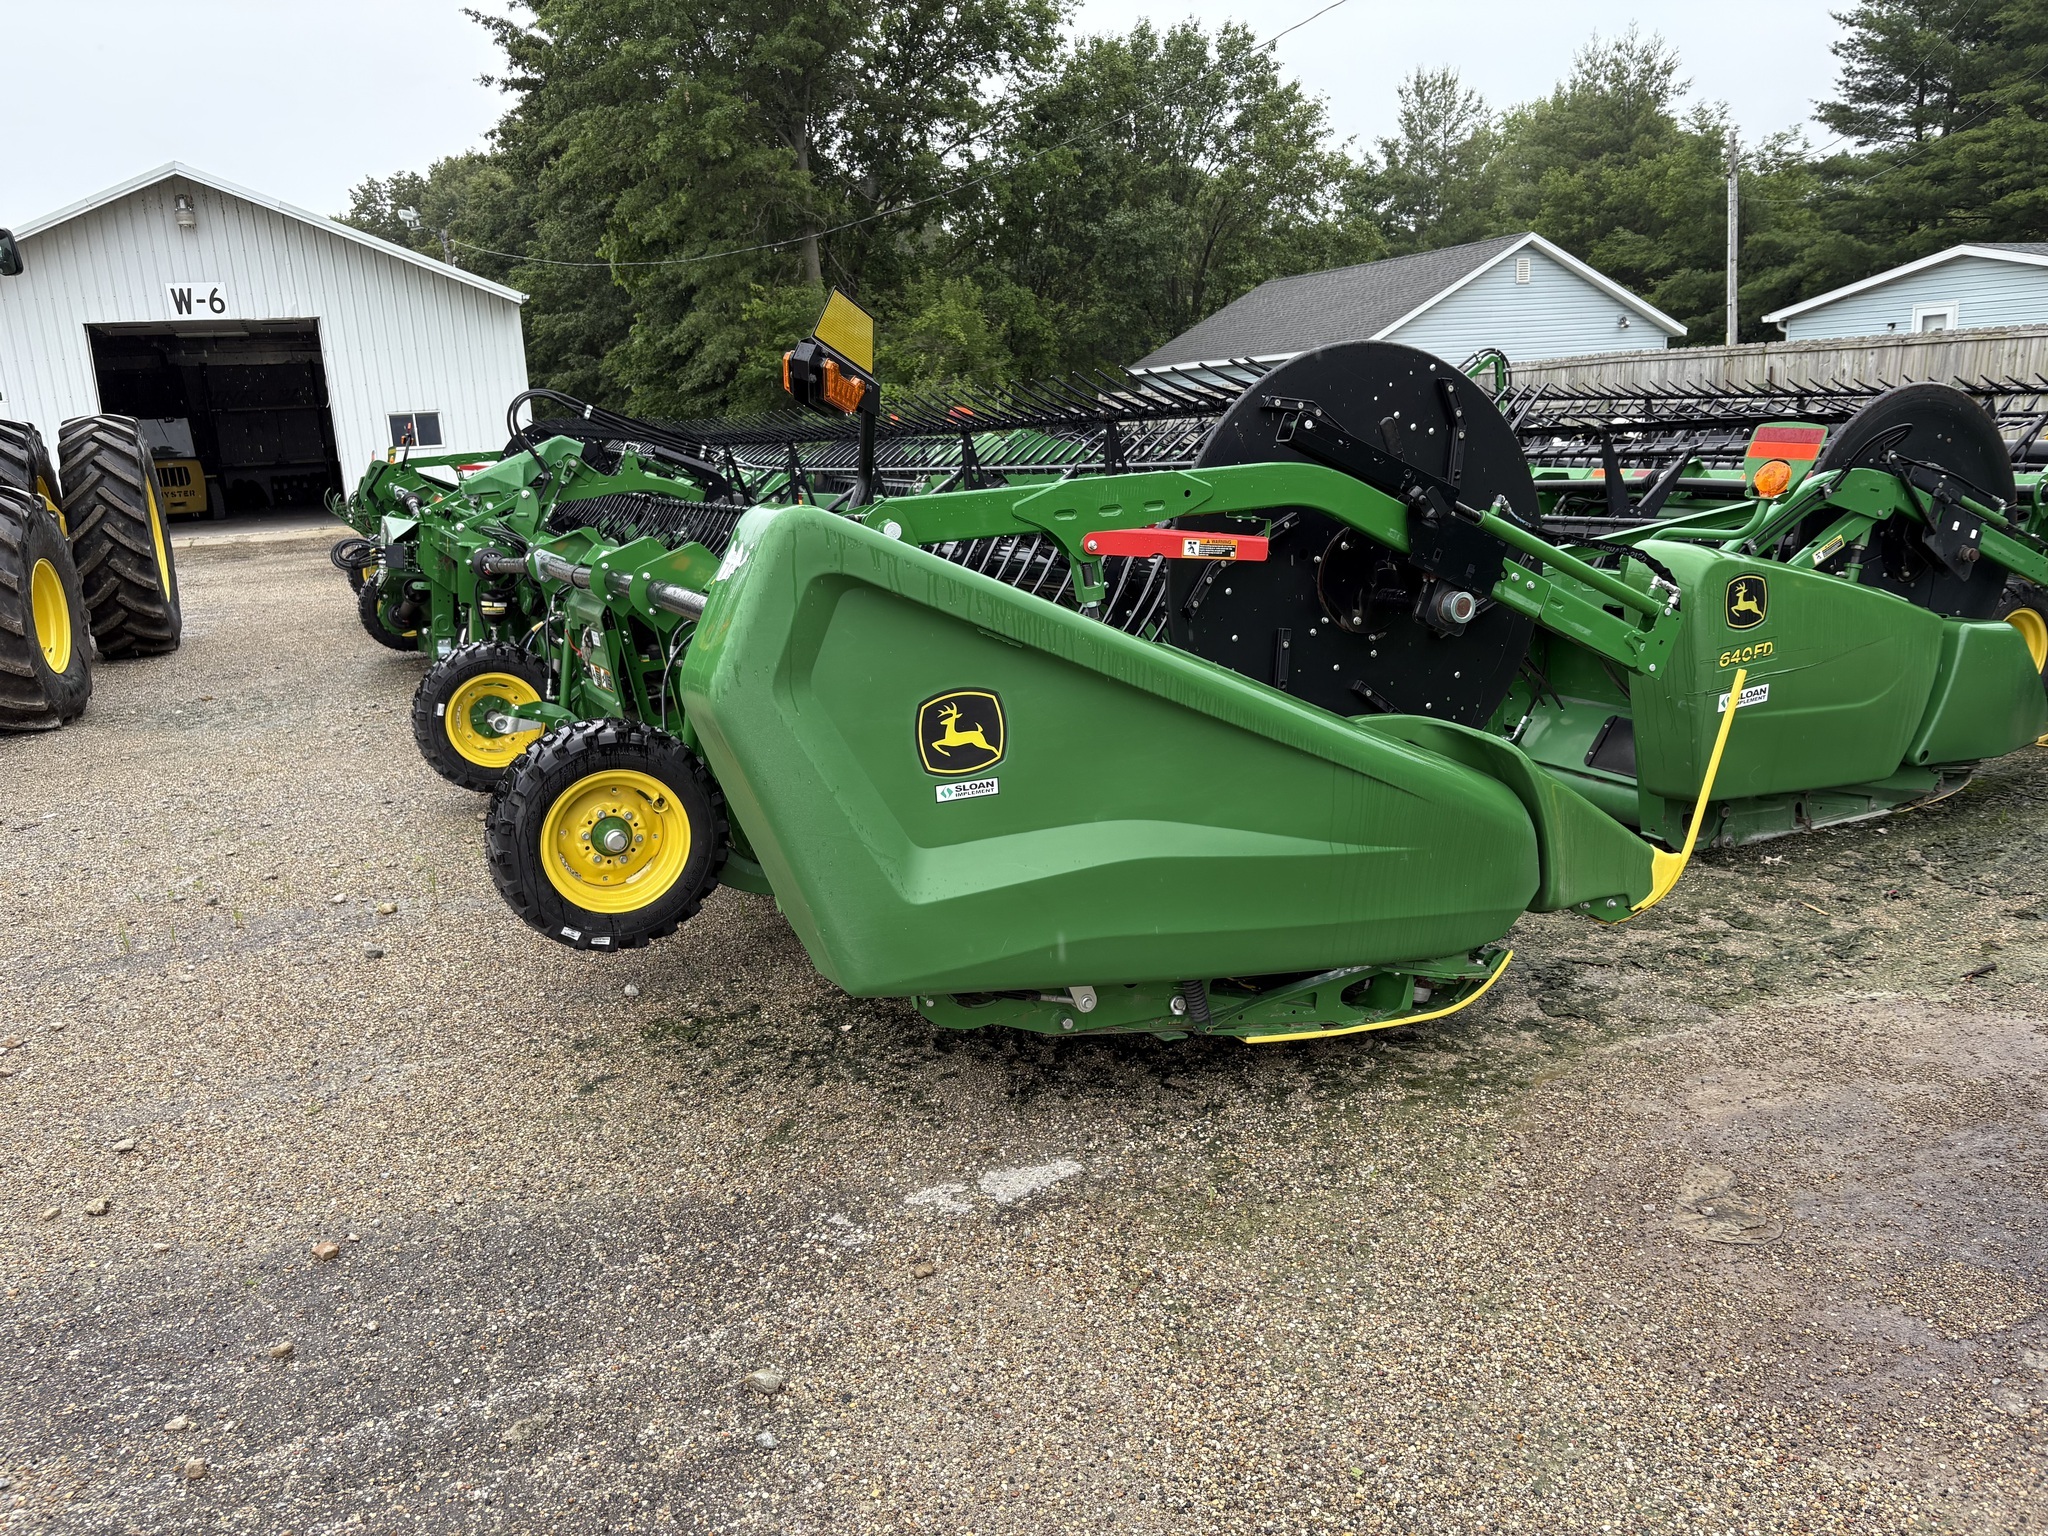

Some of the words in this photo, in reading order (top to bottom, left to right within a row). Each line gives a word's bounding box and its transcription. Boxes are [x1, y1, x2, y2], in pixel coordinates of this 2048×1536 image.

[170, 287, 226, 315] W-6
[1719, 641, 1774, 667] 640FD
[1738, 687, 1767, 699] LOAN
[1736, 695, 1766, 705] MPLEMENT
[955, 780, 995, 792] SLOAN
[955, 788, 995, 797] IMPLEMENT
